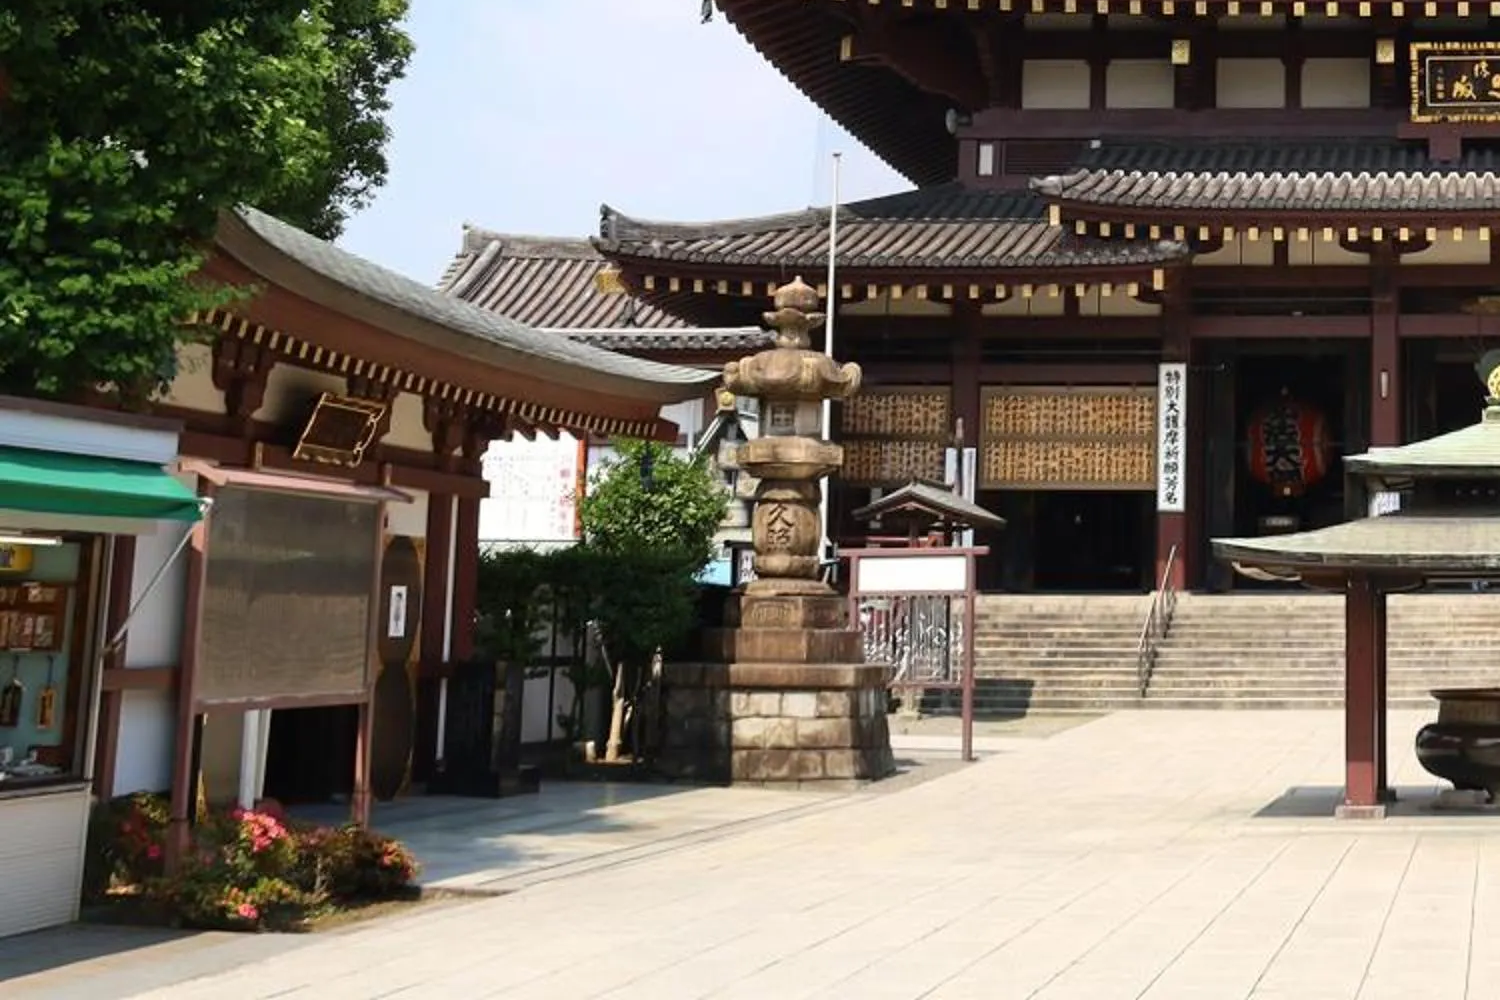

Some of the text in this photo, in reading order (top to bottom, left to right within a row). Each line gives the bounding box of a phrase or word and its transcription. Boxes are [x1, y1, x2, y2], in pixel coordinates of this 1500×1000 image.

[1163, 369, 1181, 505] 特別大護摩祈願芳名
